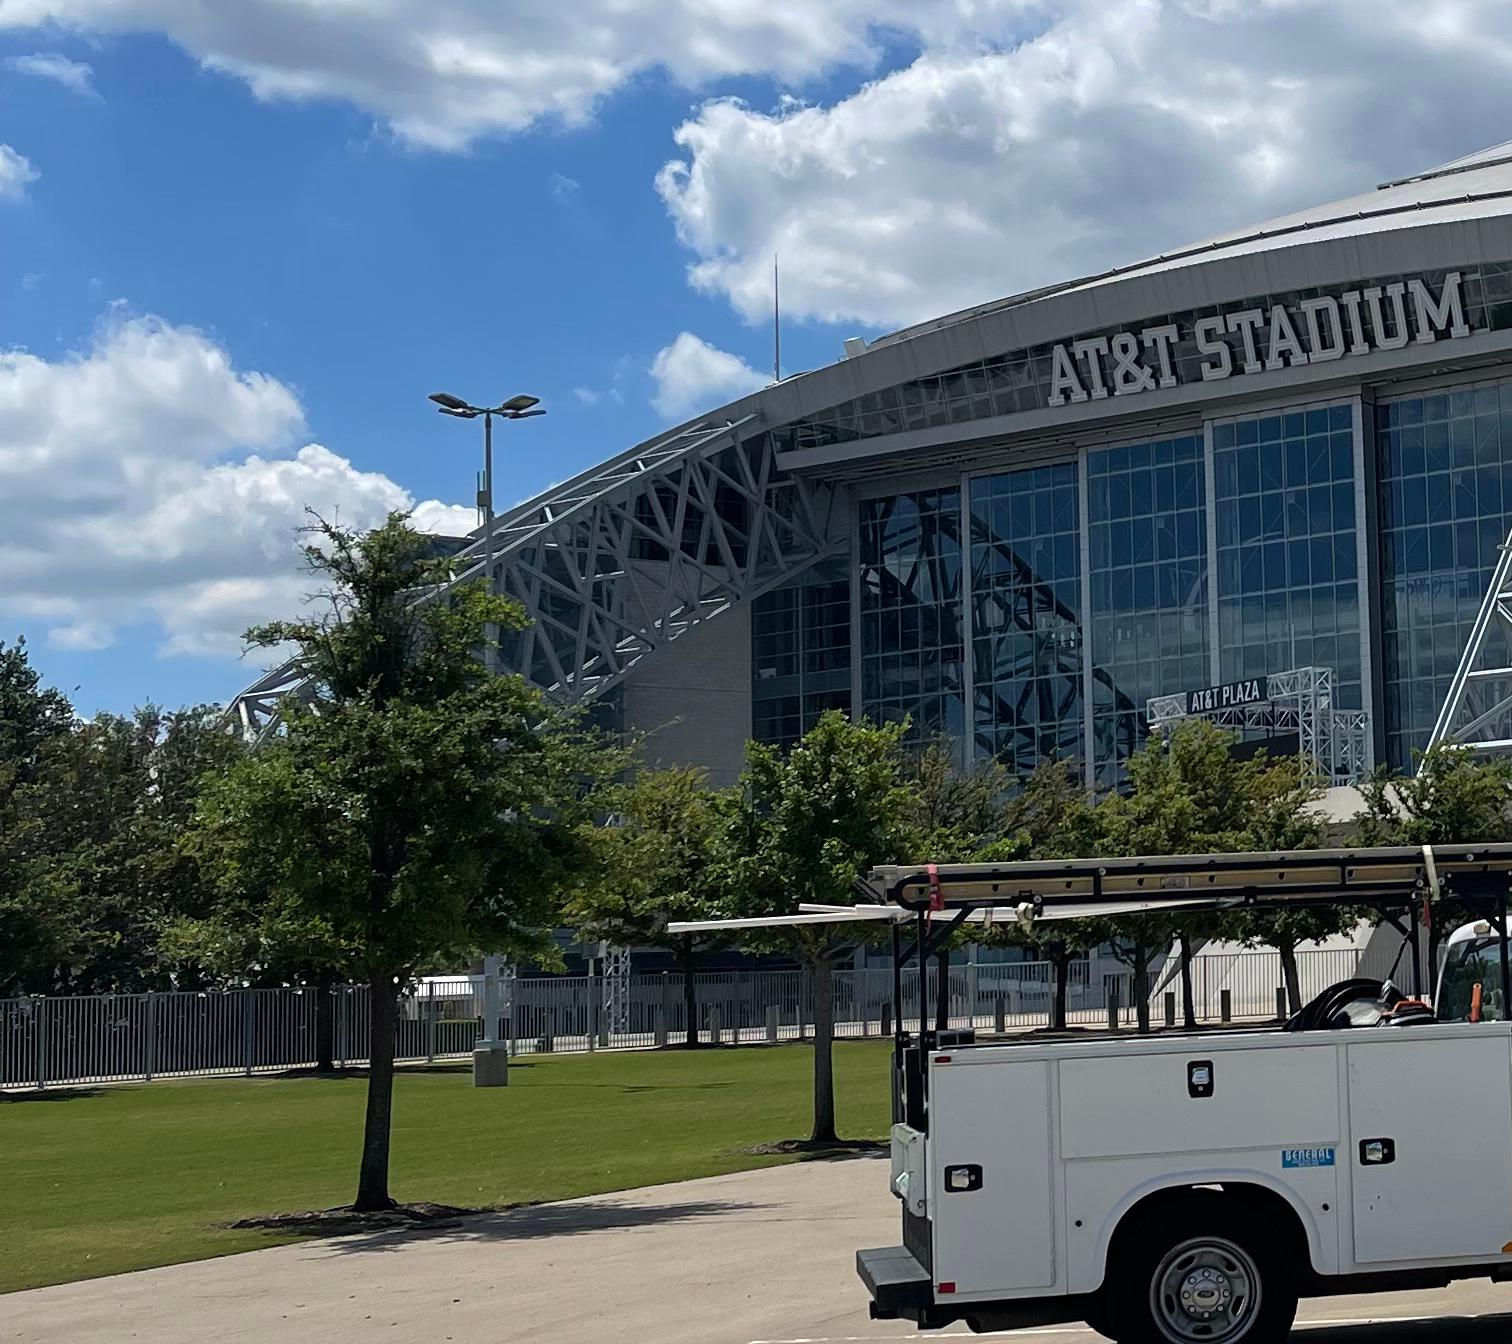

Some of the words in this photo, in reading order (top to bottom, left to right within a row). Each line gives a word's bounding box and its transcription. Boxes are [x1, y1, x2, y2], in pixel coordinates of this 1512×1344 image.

[1048, 323, 1180, 407] AT&T
[1194, 271, 1471, 381] STADIUM
[1191, 688, 1219, 712] AT&T
[1223, 680, 1259, 705] PLAZA
